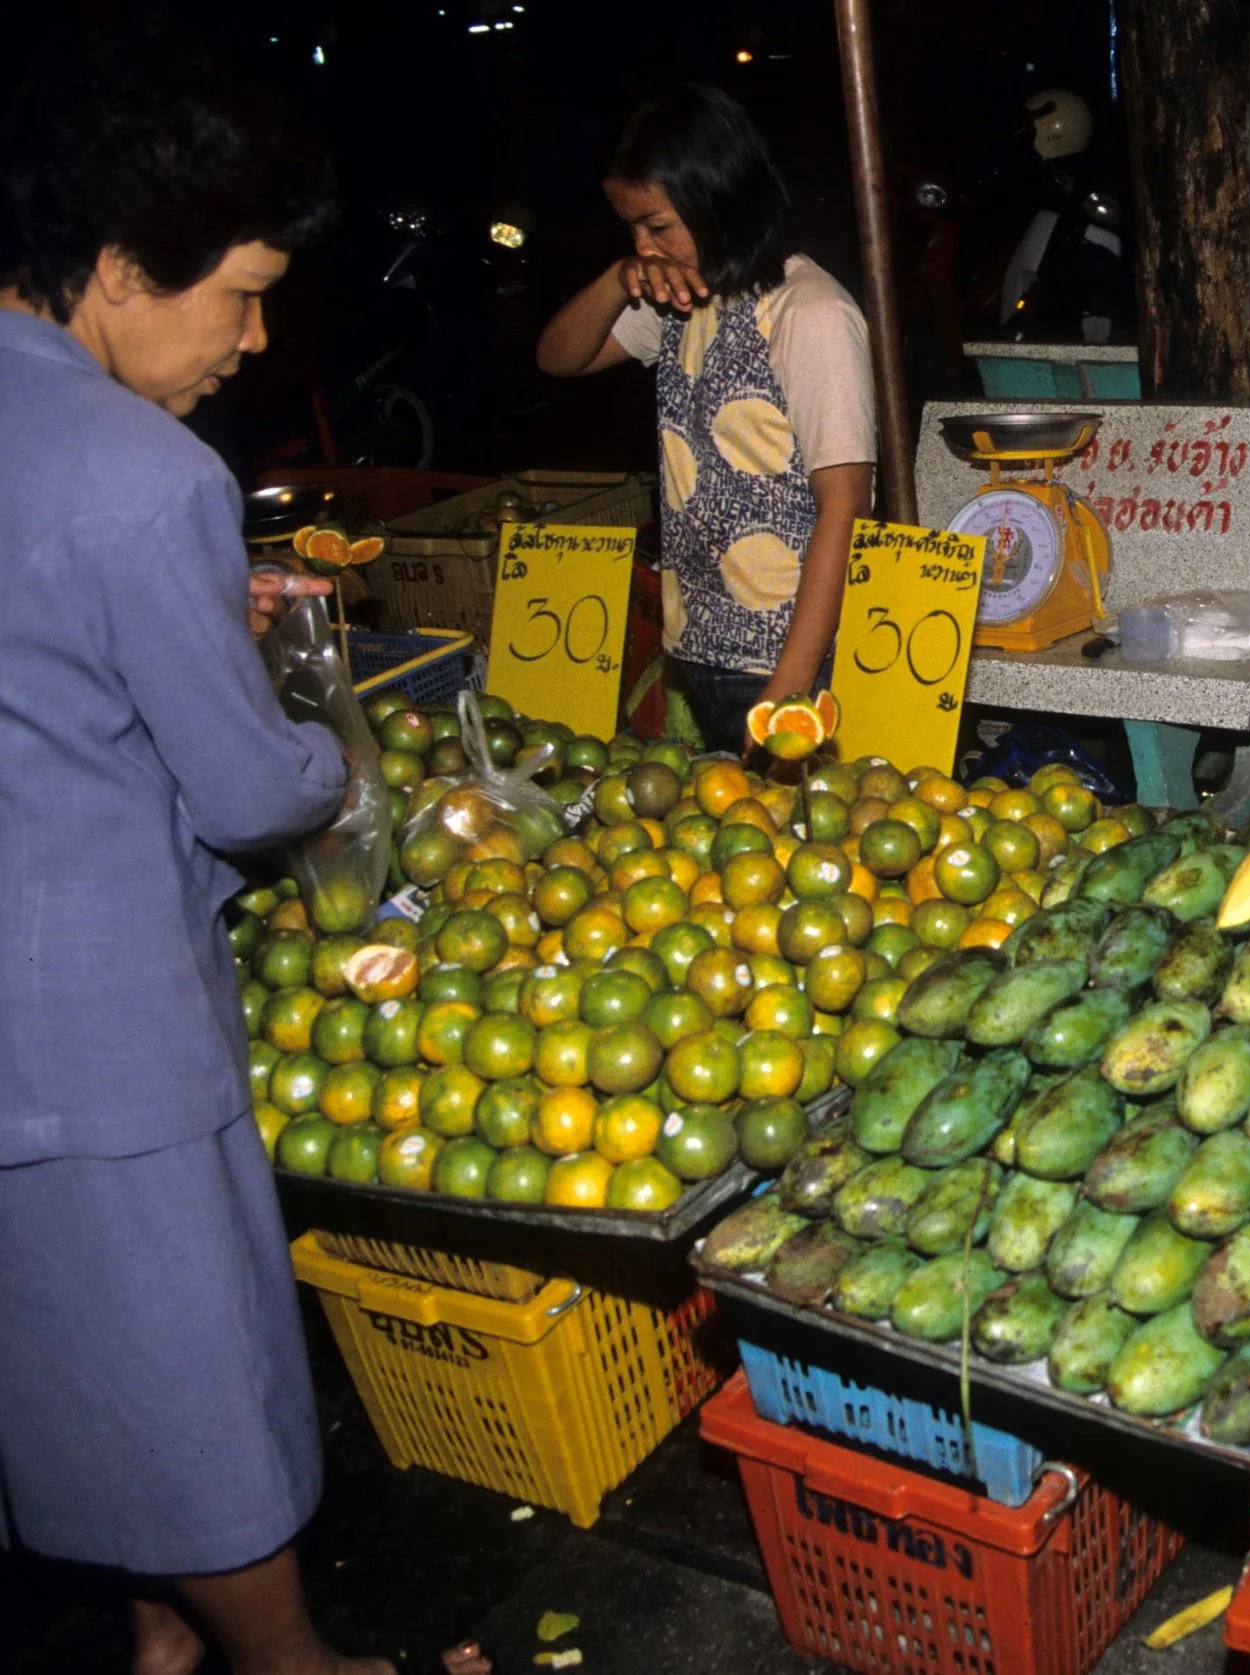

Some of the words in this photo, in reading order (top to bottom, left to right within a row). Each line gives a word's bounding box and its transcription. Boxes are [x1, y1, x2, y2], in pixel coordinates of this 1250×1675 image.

[1146, 415, 1248, 477] รับจ้าง
[507, 594, 610, 665] 30
[853, 606, 962, 686] 30
